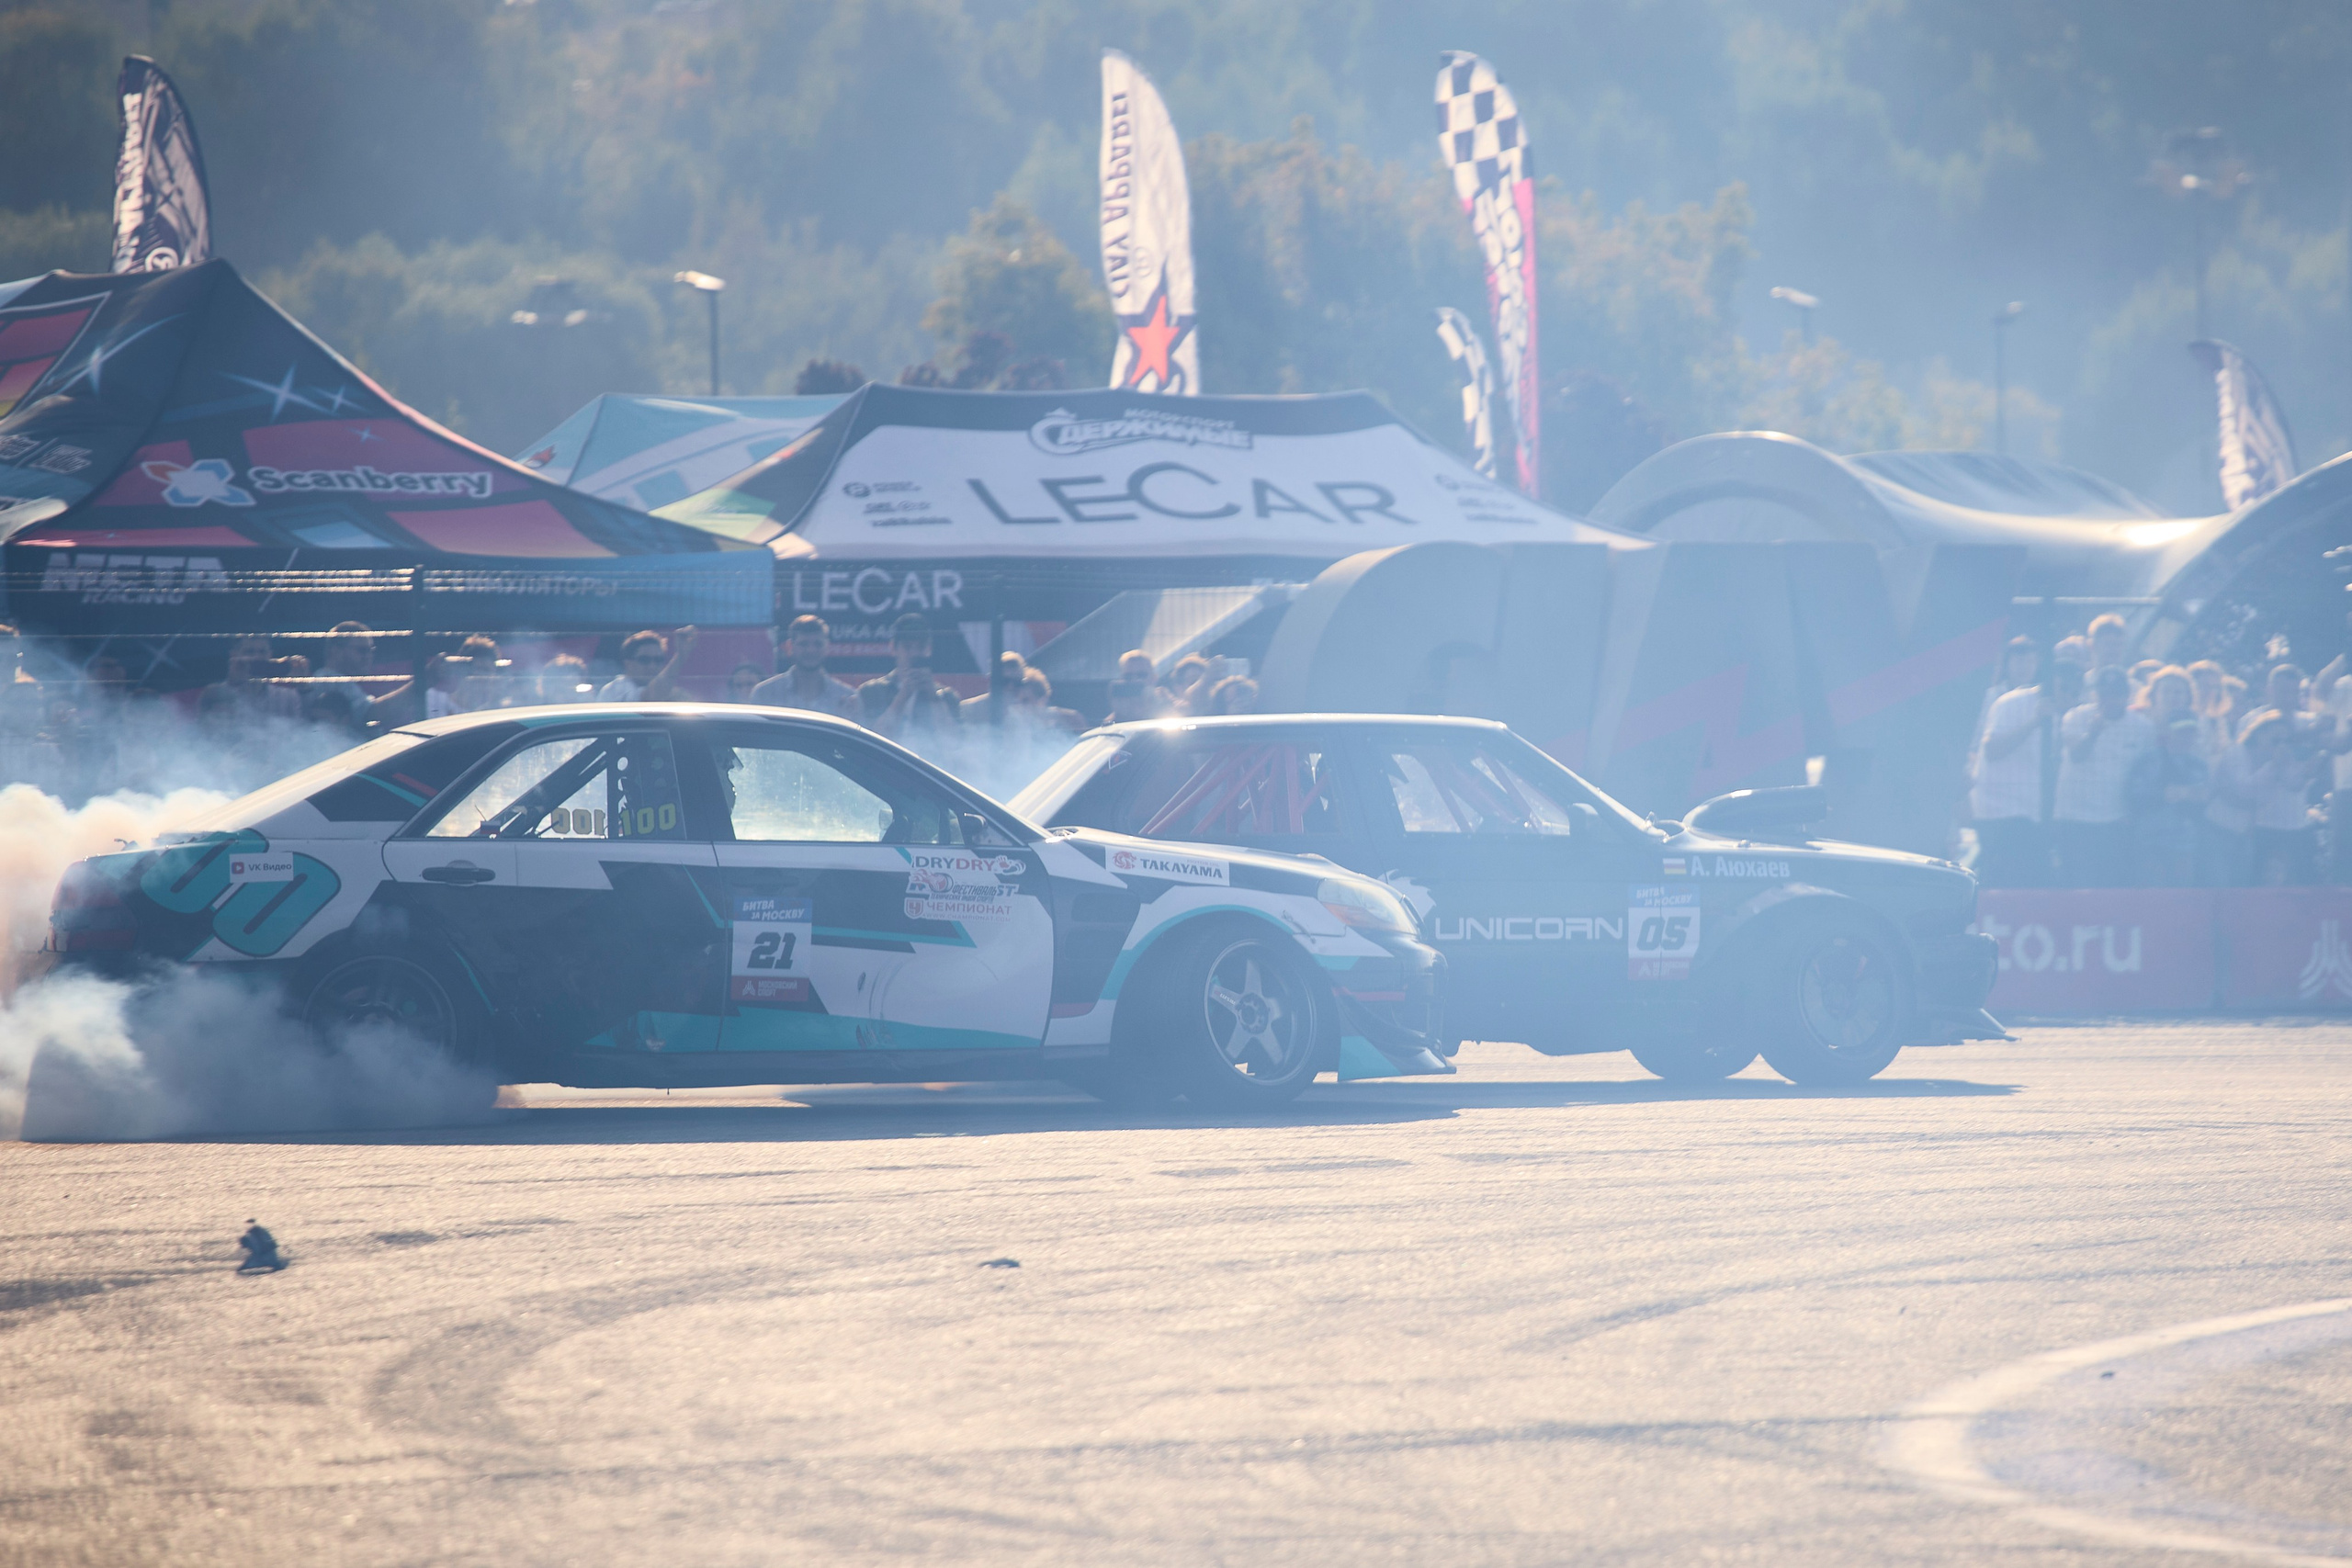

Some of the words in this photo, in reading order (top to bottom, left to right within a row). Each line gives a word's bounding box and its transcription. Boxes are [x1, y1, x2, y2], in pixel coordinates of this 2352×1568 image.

[249, 467, 492, 497] Scanberry
[967, 461, 1418, 525] LECAR
[793, 567, 963, 615] LECAR
[620, 802, 677, 836] 100
[248, 863, 262, 872] VK
[263, 863, 292, 872] Видео
[915, 855, 995, 872] DRYDRY
[1140, 858, 1223, 878] TAKAYAMA
[1690, 855, 1710, 876] А.
[1714, 855, 1791, 878] Аюхаев
[953, 883, 997, 897] ФЕСТИВАЛЬ
[1636, 886, 1665, 898] БИТВА
[742, 899, 775, 911] БИТВА
[927, 901, 1012, 915] ЧЕМПИОНАТ
[1654, 895, 1692, 907] МОСКВУ
[762, 908, 805, 921] МОСКВУ
[1435, 917, 1623, 941] UNICORN
[1636, 916, 1691, 951] 05
[747, 931, 797, 969] 21
